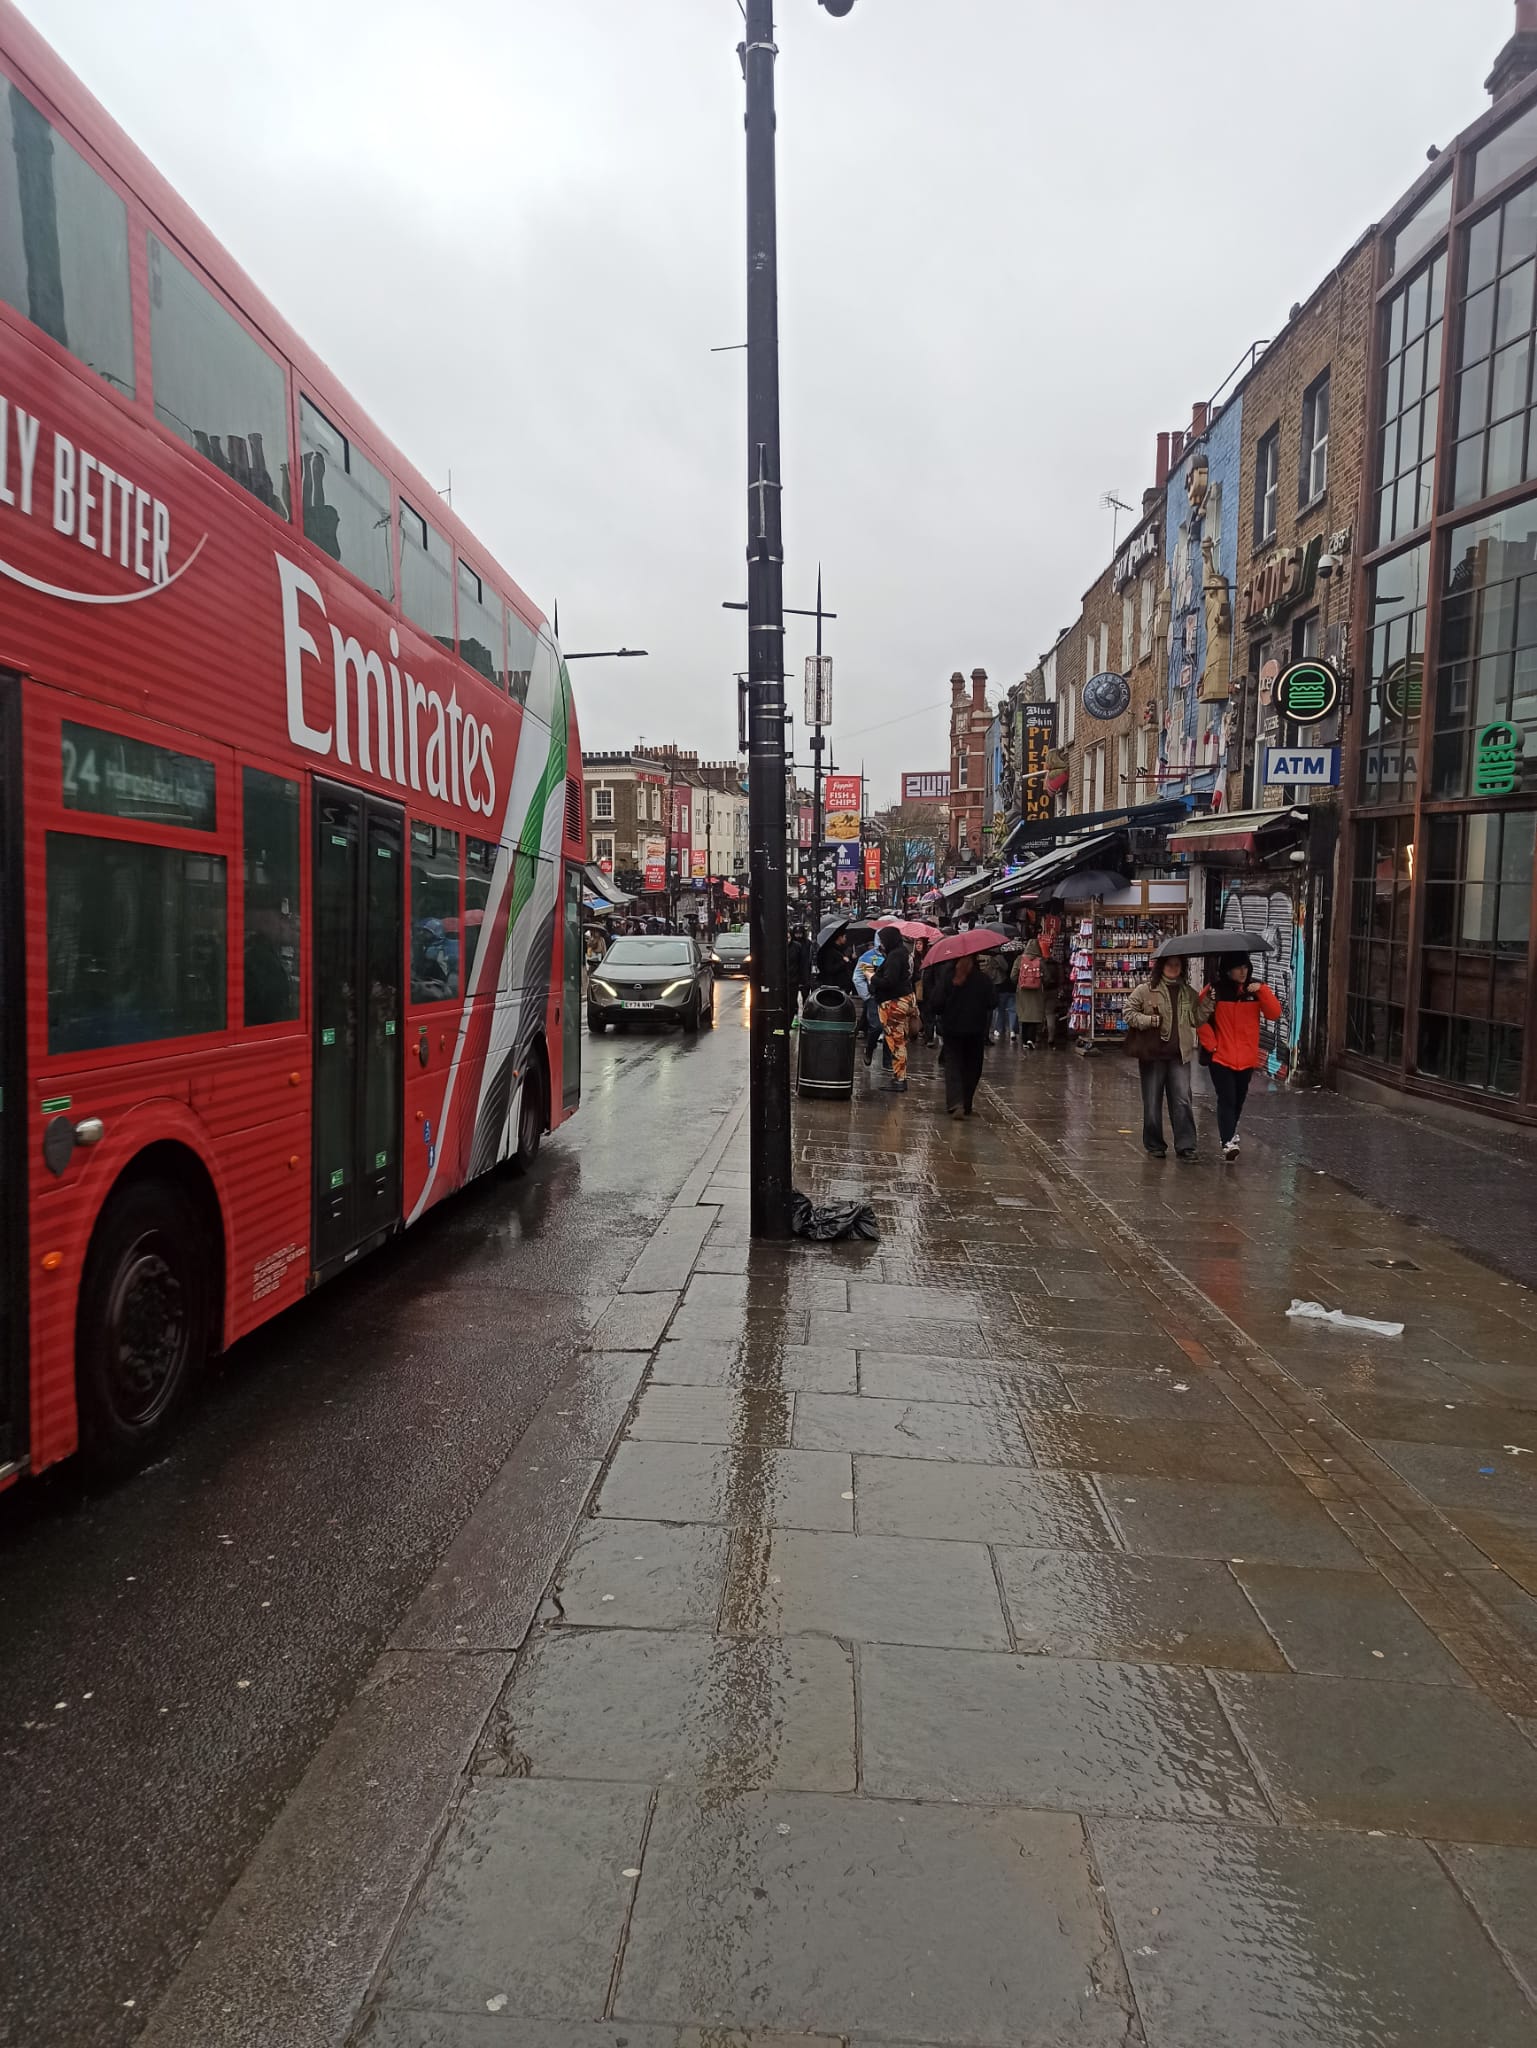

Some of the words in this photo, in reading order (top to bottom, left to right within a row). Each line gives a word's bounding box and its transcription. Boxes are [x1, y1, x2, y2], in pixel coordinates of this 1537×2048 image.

[53, 431, 171, 586] BETTER
[274, 550, 496, 817] Emirates
[1026, 706, 1052, 716] Blue
[1026, 717, 1053, 727] Skin
[62, 739, 101, 795] 24
[1027, 726, 1040, 820] PIERCING
[1273, 756, 1325, 775] ATM
[829, 791, 849, 799] FISH
